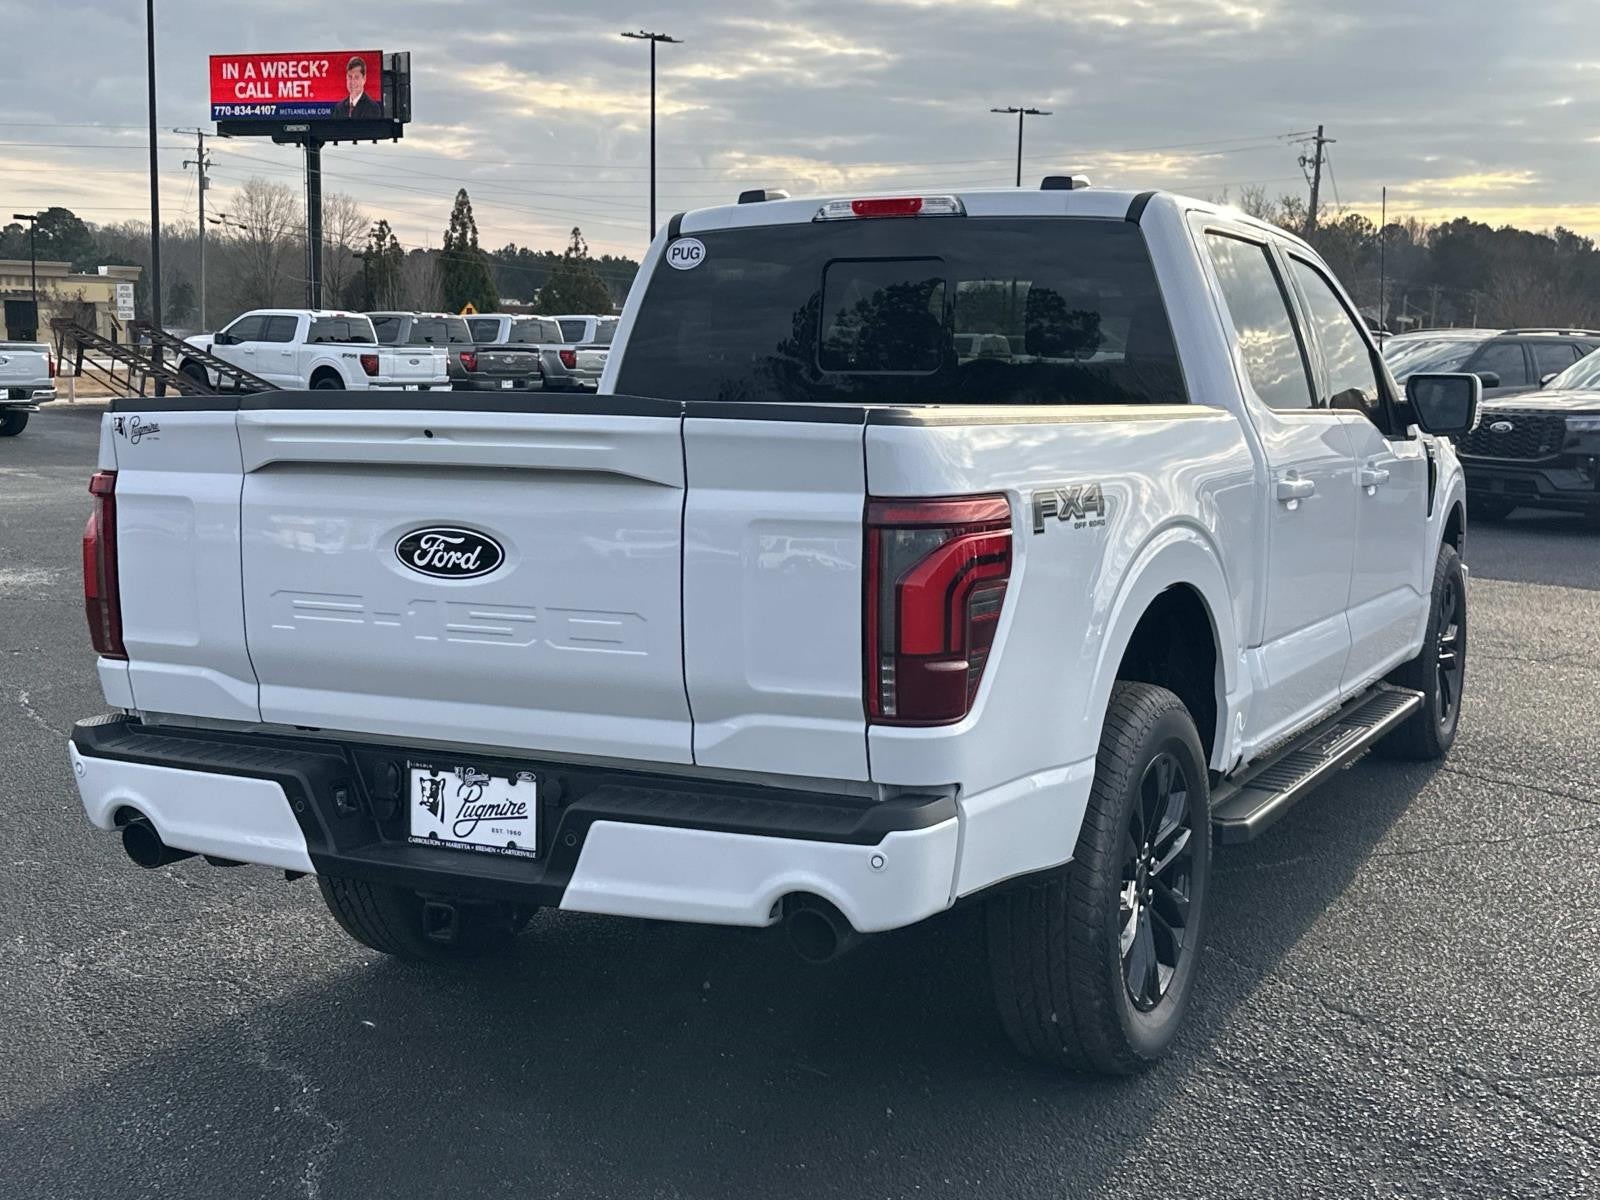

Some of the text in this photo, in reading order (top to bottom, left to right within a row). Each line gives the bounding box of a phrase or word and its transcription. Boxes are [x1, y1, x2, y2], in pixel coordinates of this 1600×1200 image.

[222, 60, 329, 79] IN A WRECK?
[234, 81, 315, 99] CALL MET.
[214, 105, 277, 116] 770-834-4107
[671, 246, 701, 261] PUG
[129, 415, 161, 445] Pugmire
[1031, 483, 1105, 536] FX4
[1074, 519, 1106, 529] OFF ROAD
[413, 533, 482, 571] Ford
[270, 589, 649, 656] F-150
[452, 781, 528, 838] Pugmire
